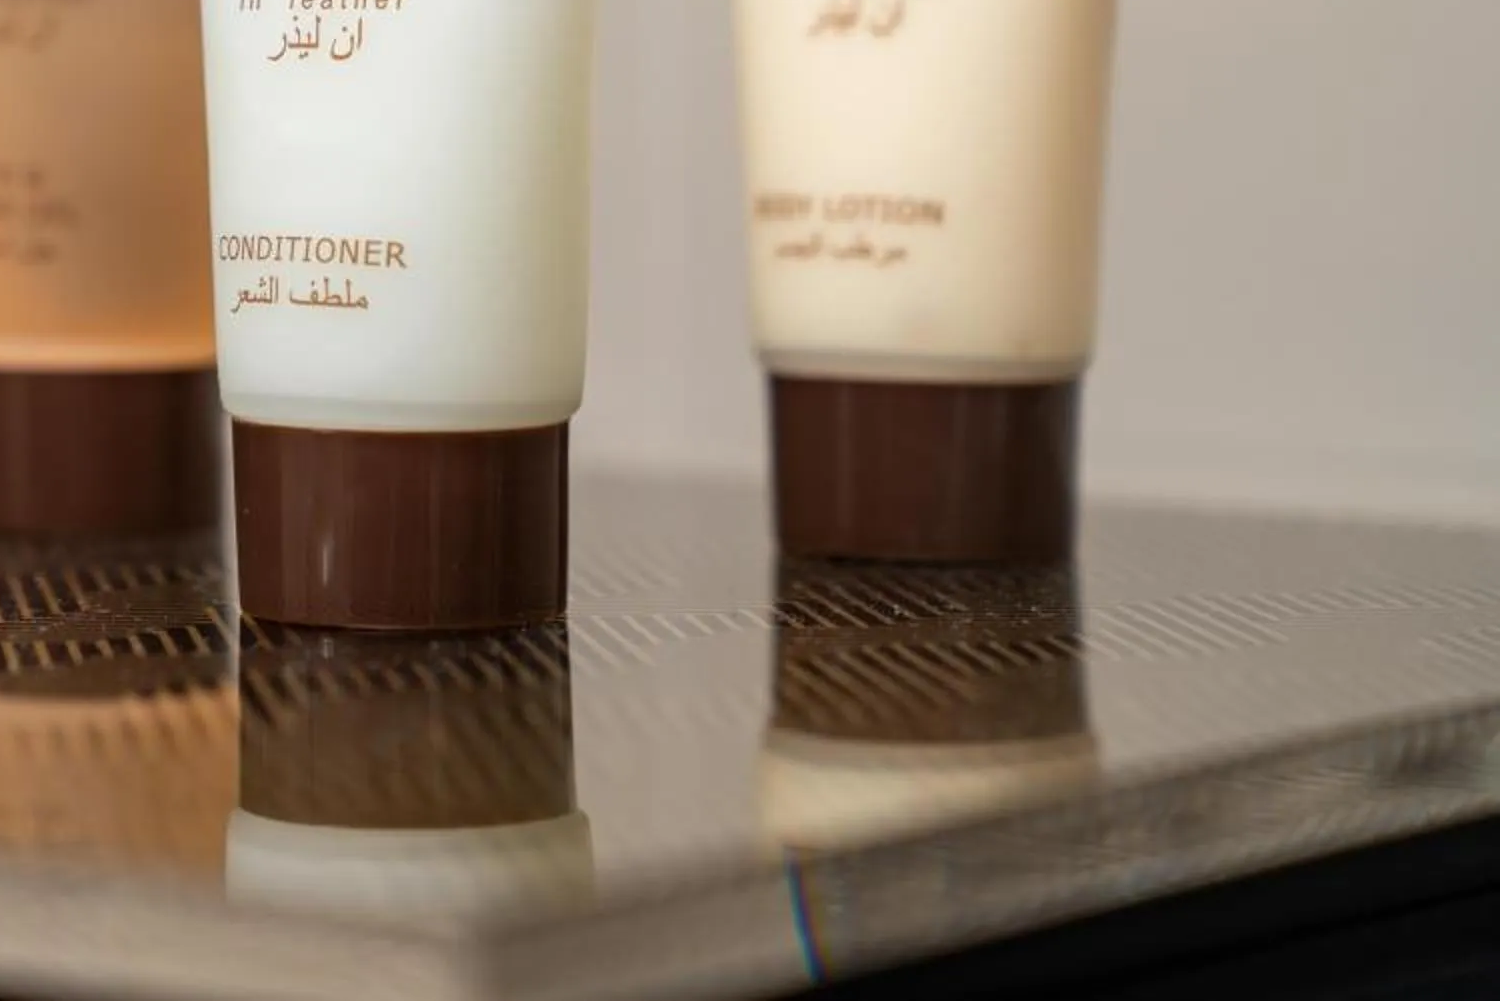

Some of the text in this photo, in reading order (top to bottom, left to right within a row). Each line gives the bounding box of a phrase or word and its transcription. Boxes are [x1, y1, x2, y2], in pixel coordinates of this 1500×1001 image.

[330, 17, 364, 60] ان
[822, 193, 947, 227] LOTION
[219, 235, 408, 269] CONDITIONER
[289, 276, 370, 310] ملطف
